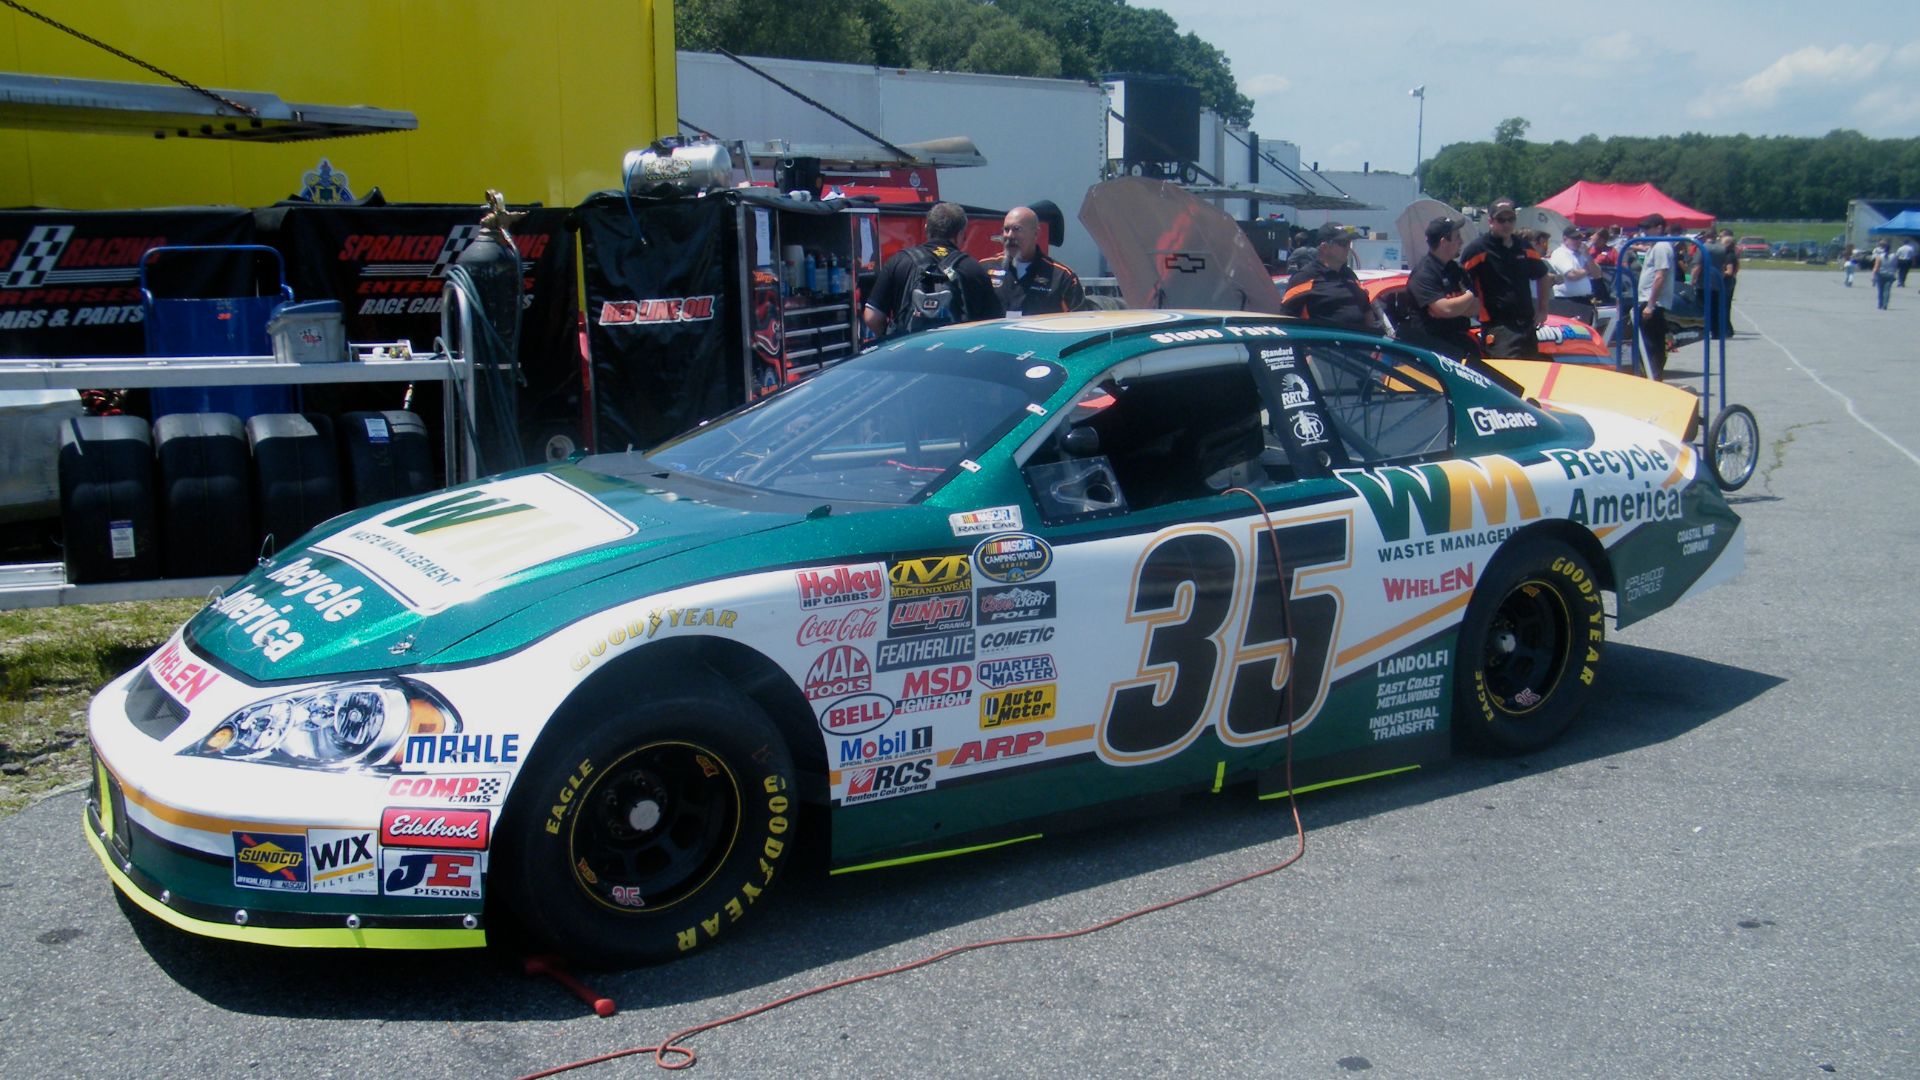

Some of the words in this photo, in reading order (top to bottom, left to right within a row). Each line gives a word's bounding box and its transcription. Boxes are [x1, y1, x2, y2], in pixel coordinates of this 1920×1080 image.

[60, 236, 167, 267] RACING
[339, 235, 445, 261] SPRAKER
[0, 309, 48, 329] ARS
[48, 308, 70, 327] &
[72, 305, 145, 326] PARTS
[358, 299, 403, 315] RACE
[1260, 346, 1294, 359] Standard
[1281, 390, 1303, 405] RRT
[1468, 407, 1538, 435] Gilbane
[1551, 446, 1670, 481] Recycle
[1567, 481, 1683, 526] America
[984, 553, 1016, 564] CAMPING
[1017, 550, 1042, 560] WORLD
[1001, 539, 1033, 553] NASCAR
[1378, 541, 1435, 563] WASTE
[380, 540, 460, 586] MANAGEMENT
[266, 557, 364, 622] Recycle
[798, 567, 883, 599] Holley
[891, 585, 942, 598] MECHANIX
[943, 579, 971, 593] WEAR
[1383, 562, 1474, 603] WHELEN
[802, 598, 820, 608] HP
[824, 591, 868, 605] CARBS
[891, 596, 965, 624] LUNATI
[218, 584, 304, 664] America
[939, 620, 971, 630] CRANKS
[991, 608, 1041, 620] POLE
[1551, 556, 1602, 687] GOODYEAR
[796, 607, 882, 647] Coca-Cola
[981, 626, 1055, 649] COMETIC
[1098, 509, 1353, 764] 35
[878, 634, 974, 666] FEATHERLITE
[150, 640, 221, 704] WHELEN
[807, 647, 869, 685] MAC
[980, 656, 1050, 680] QUARTER
[1377, 649, 1449, 678] LANDOLFI
[806, 678, 870, 699] TOOLS
[902, 665, 972, 699] MSD
[992, 667, 1053, 687] MASTER
[1376, 680, 1406, 697] EAST
[1406, 674, 1444, 691] COAST
[900, 692, 967, 714] IGNITION
[999, 701, 1052, 720] Meter
[1002, 690, 1043, 708] Auto
[1376, 687, 1441, 710] METALWORKS
[829, 702, 886, 728] BELL
[1369, 706, 1440, 730] INDUSTRIAL
[405, 734, 519, 763] MAHLE
[840, 730, 907, 762] Mobil
[950, 731, 1044, 765] ARP
[872, 758, 933, 791] RCS
[388, 777, 480, 798] COMP
[448, 795, 491, 803] CAMS
[545, 758, 594, 835] EAGLE
[845, 793, 878, 803] Renton
[879, 787, 897, 796] Coil
[898, 782, 928, 794] Spring
[389, 814, 479, 839] Edelbrock
[241, 850, 302, 865] SUNOCO
[310, 833, 374, 871] WIX
[675, 774, 789, 951] GOODYEAR
[312, 870, 375, 890] FILTERS
[386, 854, 475, 892] JE
[413, 887, 481, 897] PISTONS
